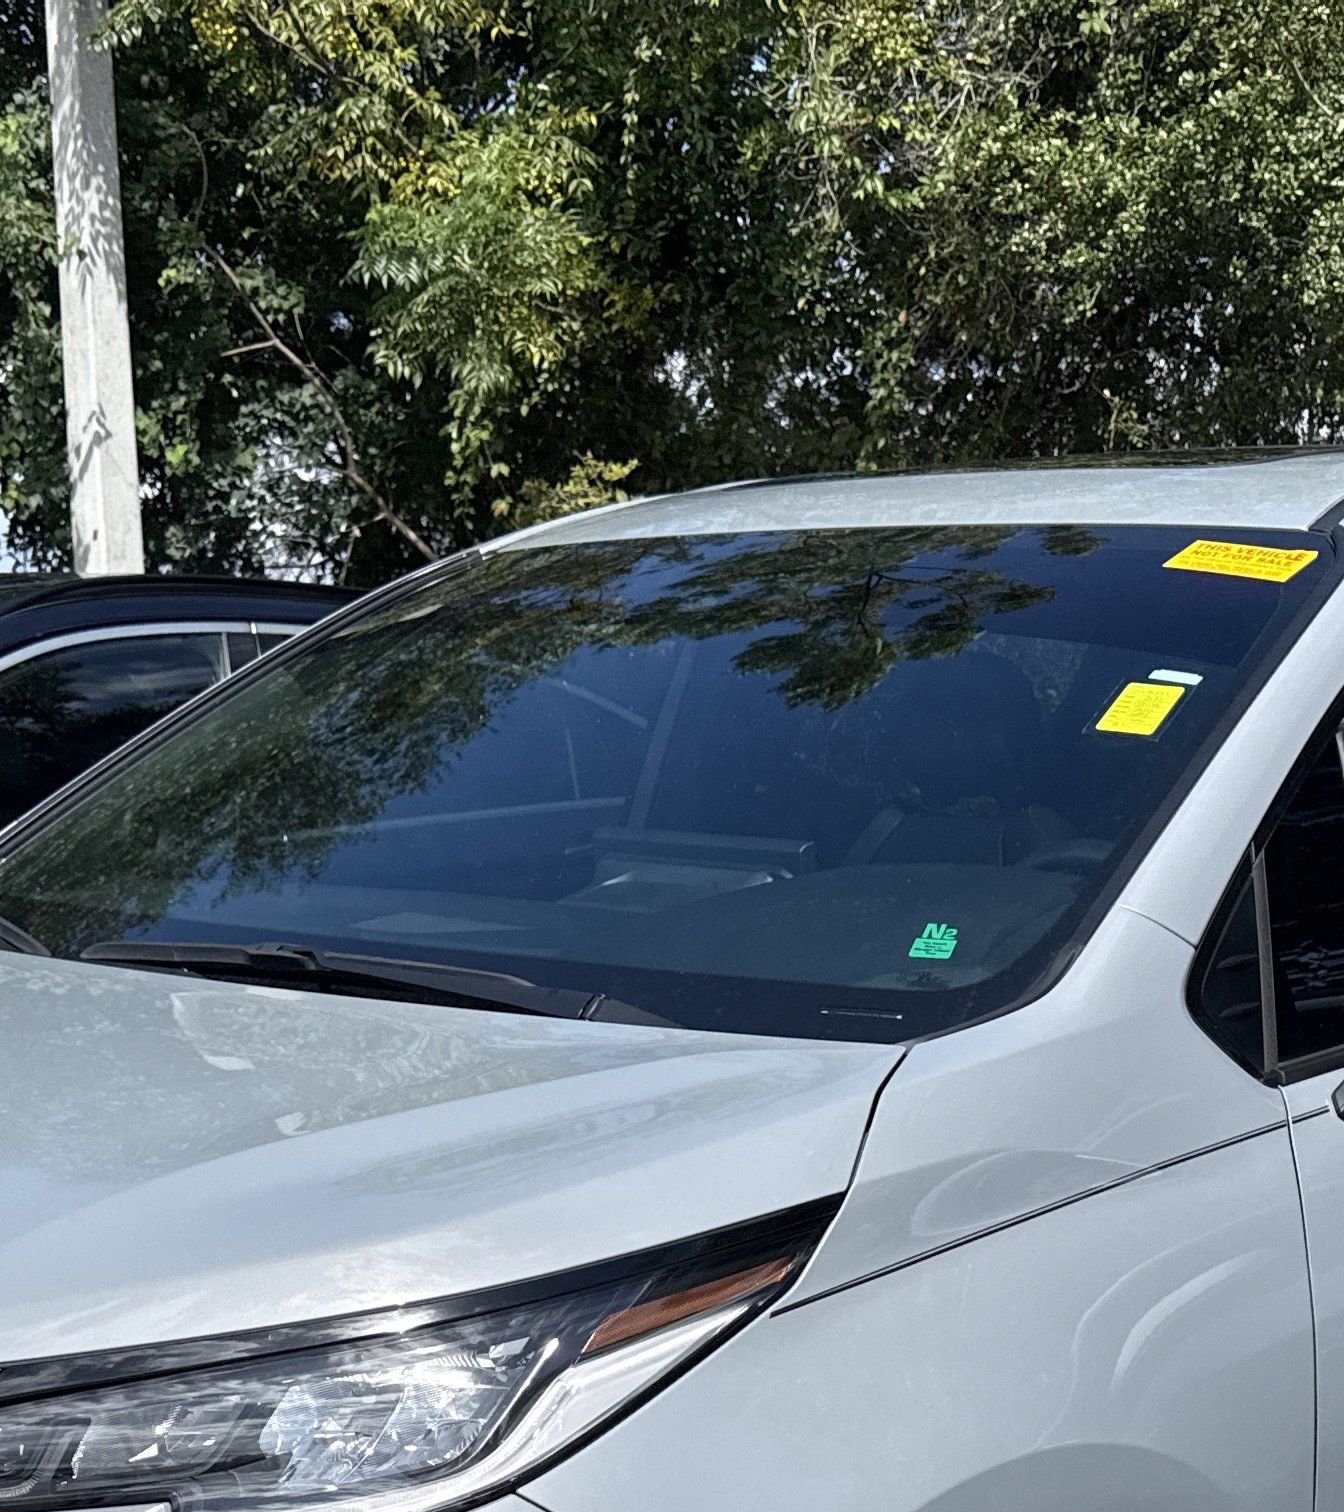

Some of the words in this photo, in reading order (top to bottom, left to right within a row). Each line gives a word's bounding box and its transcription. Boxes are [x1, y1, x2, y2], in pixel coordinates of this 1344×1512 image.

[1196, 543, 1232, 552] THIS
[1237, 546, 1309, 562] VEHICLE
[1222, 553, 1252, 561] FOR
[1256, 556, 1296, 567] SALE
